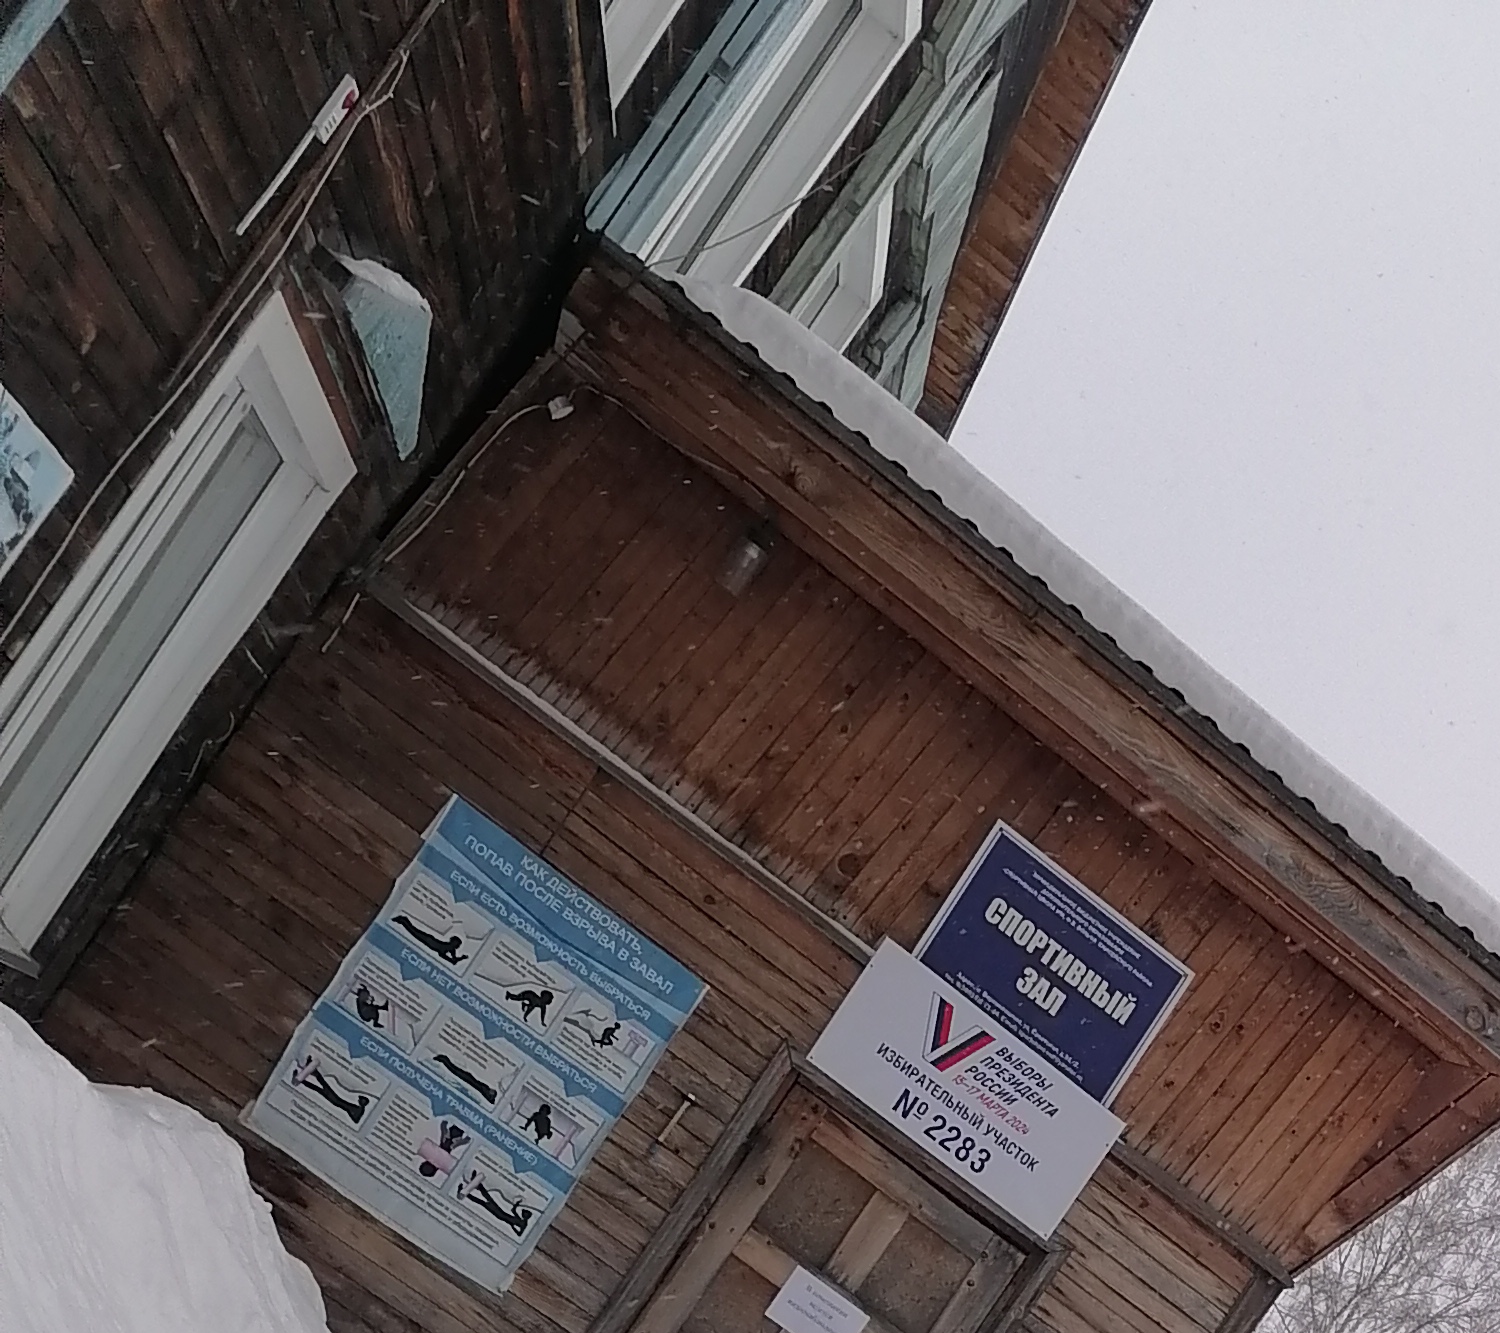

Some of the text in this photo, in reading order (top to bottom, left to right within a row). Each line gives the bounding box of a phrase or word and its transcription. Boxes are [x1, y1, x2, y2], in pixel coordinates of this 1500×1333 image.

[449, 869, 481, 896] ЕСЛИ
[479, 891, 510, 917] ЕСТЬ
[507, 912, 590, 976] ВОЗМОЖНОСТЬ
[588, 971, 651, 1021] ВЫБРАТЬСЯ
[463, 834, 674, 994] ПОПАВ ПОСЛЕ ВЗРЫВА В ЗАВАЛ
[519, 854, 647, 955] КАК ДЕЙСТВОВАТЬ,
[982, 895, 1137, 1025] СПОРТИВНЫЙ
[1012, 965, 1067, 1017] ЗАЛ
[399, 947, 432, 974] ЕСЛИ
[429, 969, 455, 991] НЕТ
[451, 985, 537, 1050] ВОЗМОЖНОСТИ
[533, 1044, 598, 1093] ВЫБРАТЬСЯ
[994, 1045, 1053, 1091] ВЫБОРЫ
[358, 1035, 390, 1060] ЕСЛИ
[387, 1055, 445, 1099] ПОЛУЧЕНА
[442, 1094, 486, 1128] ТРАВМА
[482, 1122, 539, 1166] (РАНЕНИЕ)
[876, 1042, 1039, 1172] ИЗБИРАТЕЛЬНЫЙ УЧАСТОК
[891, 1087, 993, 1175] № 2283
[964, 1064, 1018, 1106] РОССИИ
[976, 1093, 1009, 1119] МАРТА
[1005, 1115, 1030, 1135] 2024
[979, 1055, 1058, 1118] ПРЕЗИДЕНТА
